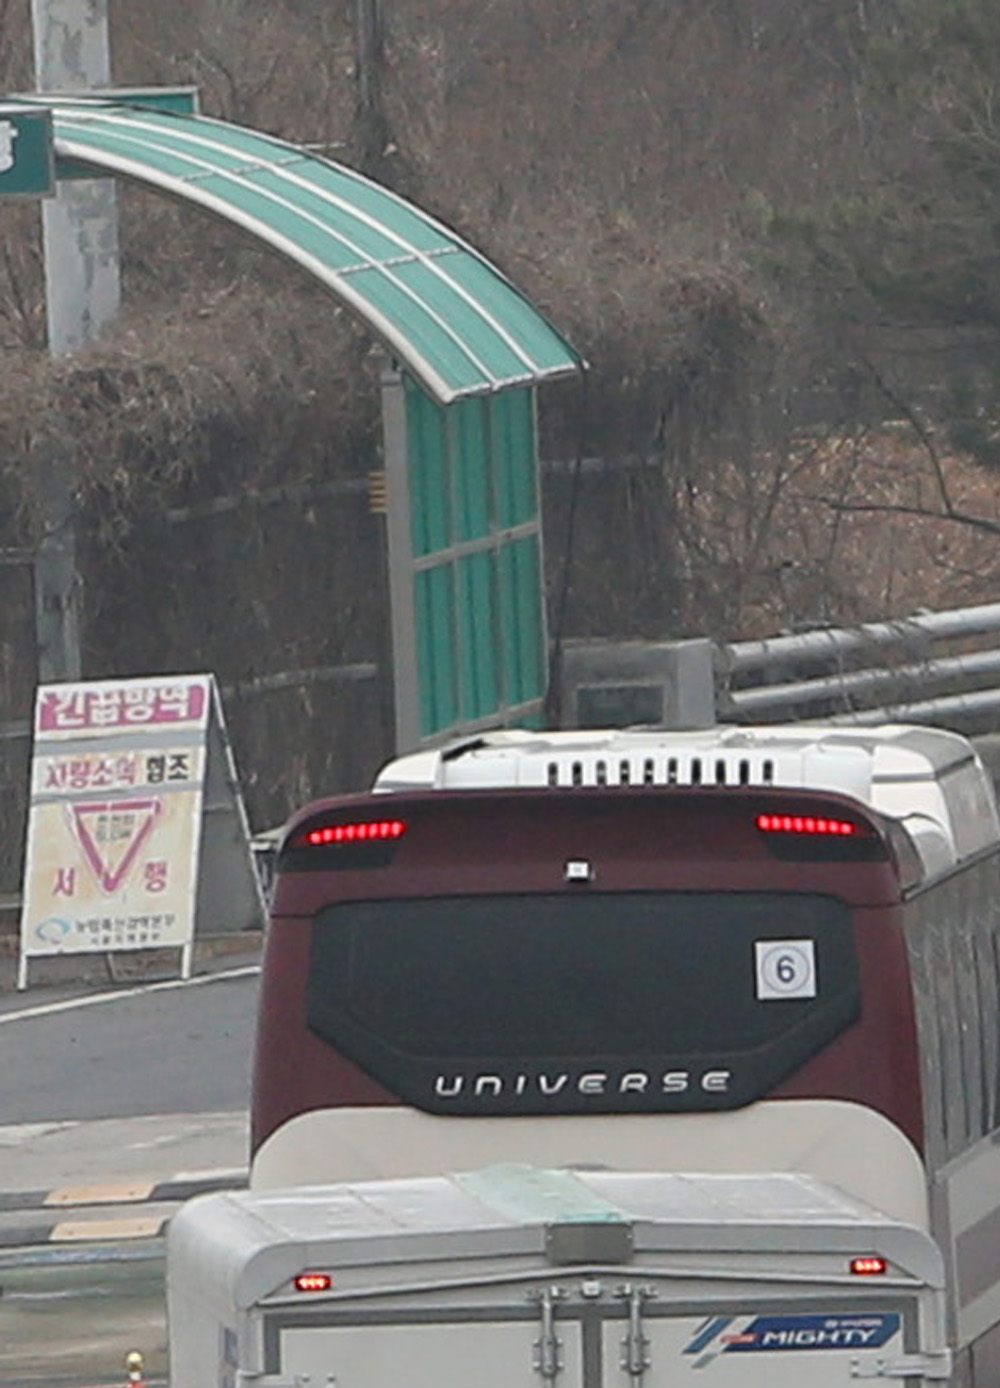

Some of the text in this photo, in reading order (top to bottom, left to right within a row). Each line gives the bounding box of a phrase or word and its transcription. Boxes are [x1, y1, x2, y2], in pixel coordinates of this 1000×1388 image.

[146, 754, 188, 783] 협조
[53, 862, 167, 896] 서 행
[775, 957, 796, 983] 6
[436, 1070, 732, 1096] UNIVERSE
[762, 1329, 877, 1345] MIGHTY
